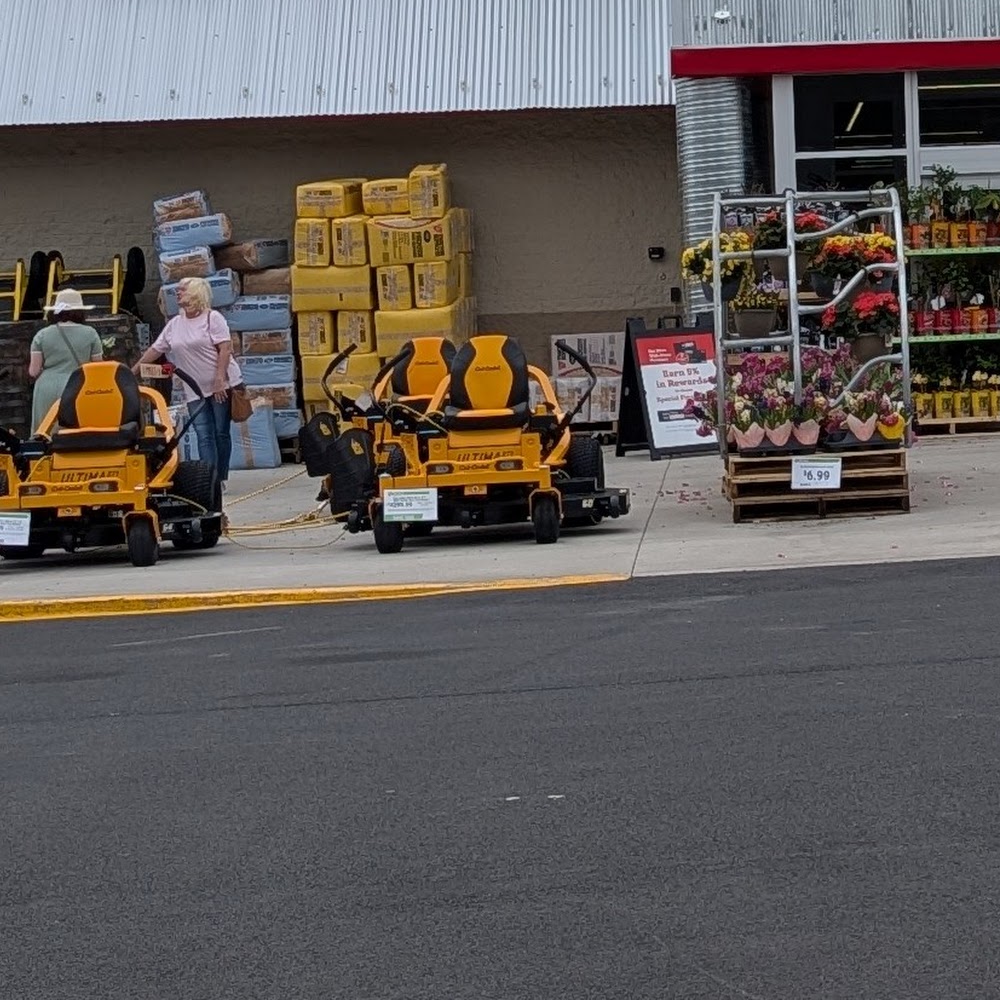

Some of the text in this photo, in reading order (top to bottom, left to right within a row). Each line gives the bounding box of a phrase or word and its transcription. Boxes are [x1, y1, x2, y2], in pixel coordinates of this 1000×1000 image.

[662, 370, 685, 378] Earn
[656, 380, 666, 388] in
[803, 469, 830, 481] $6.99
